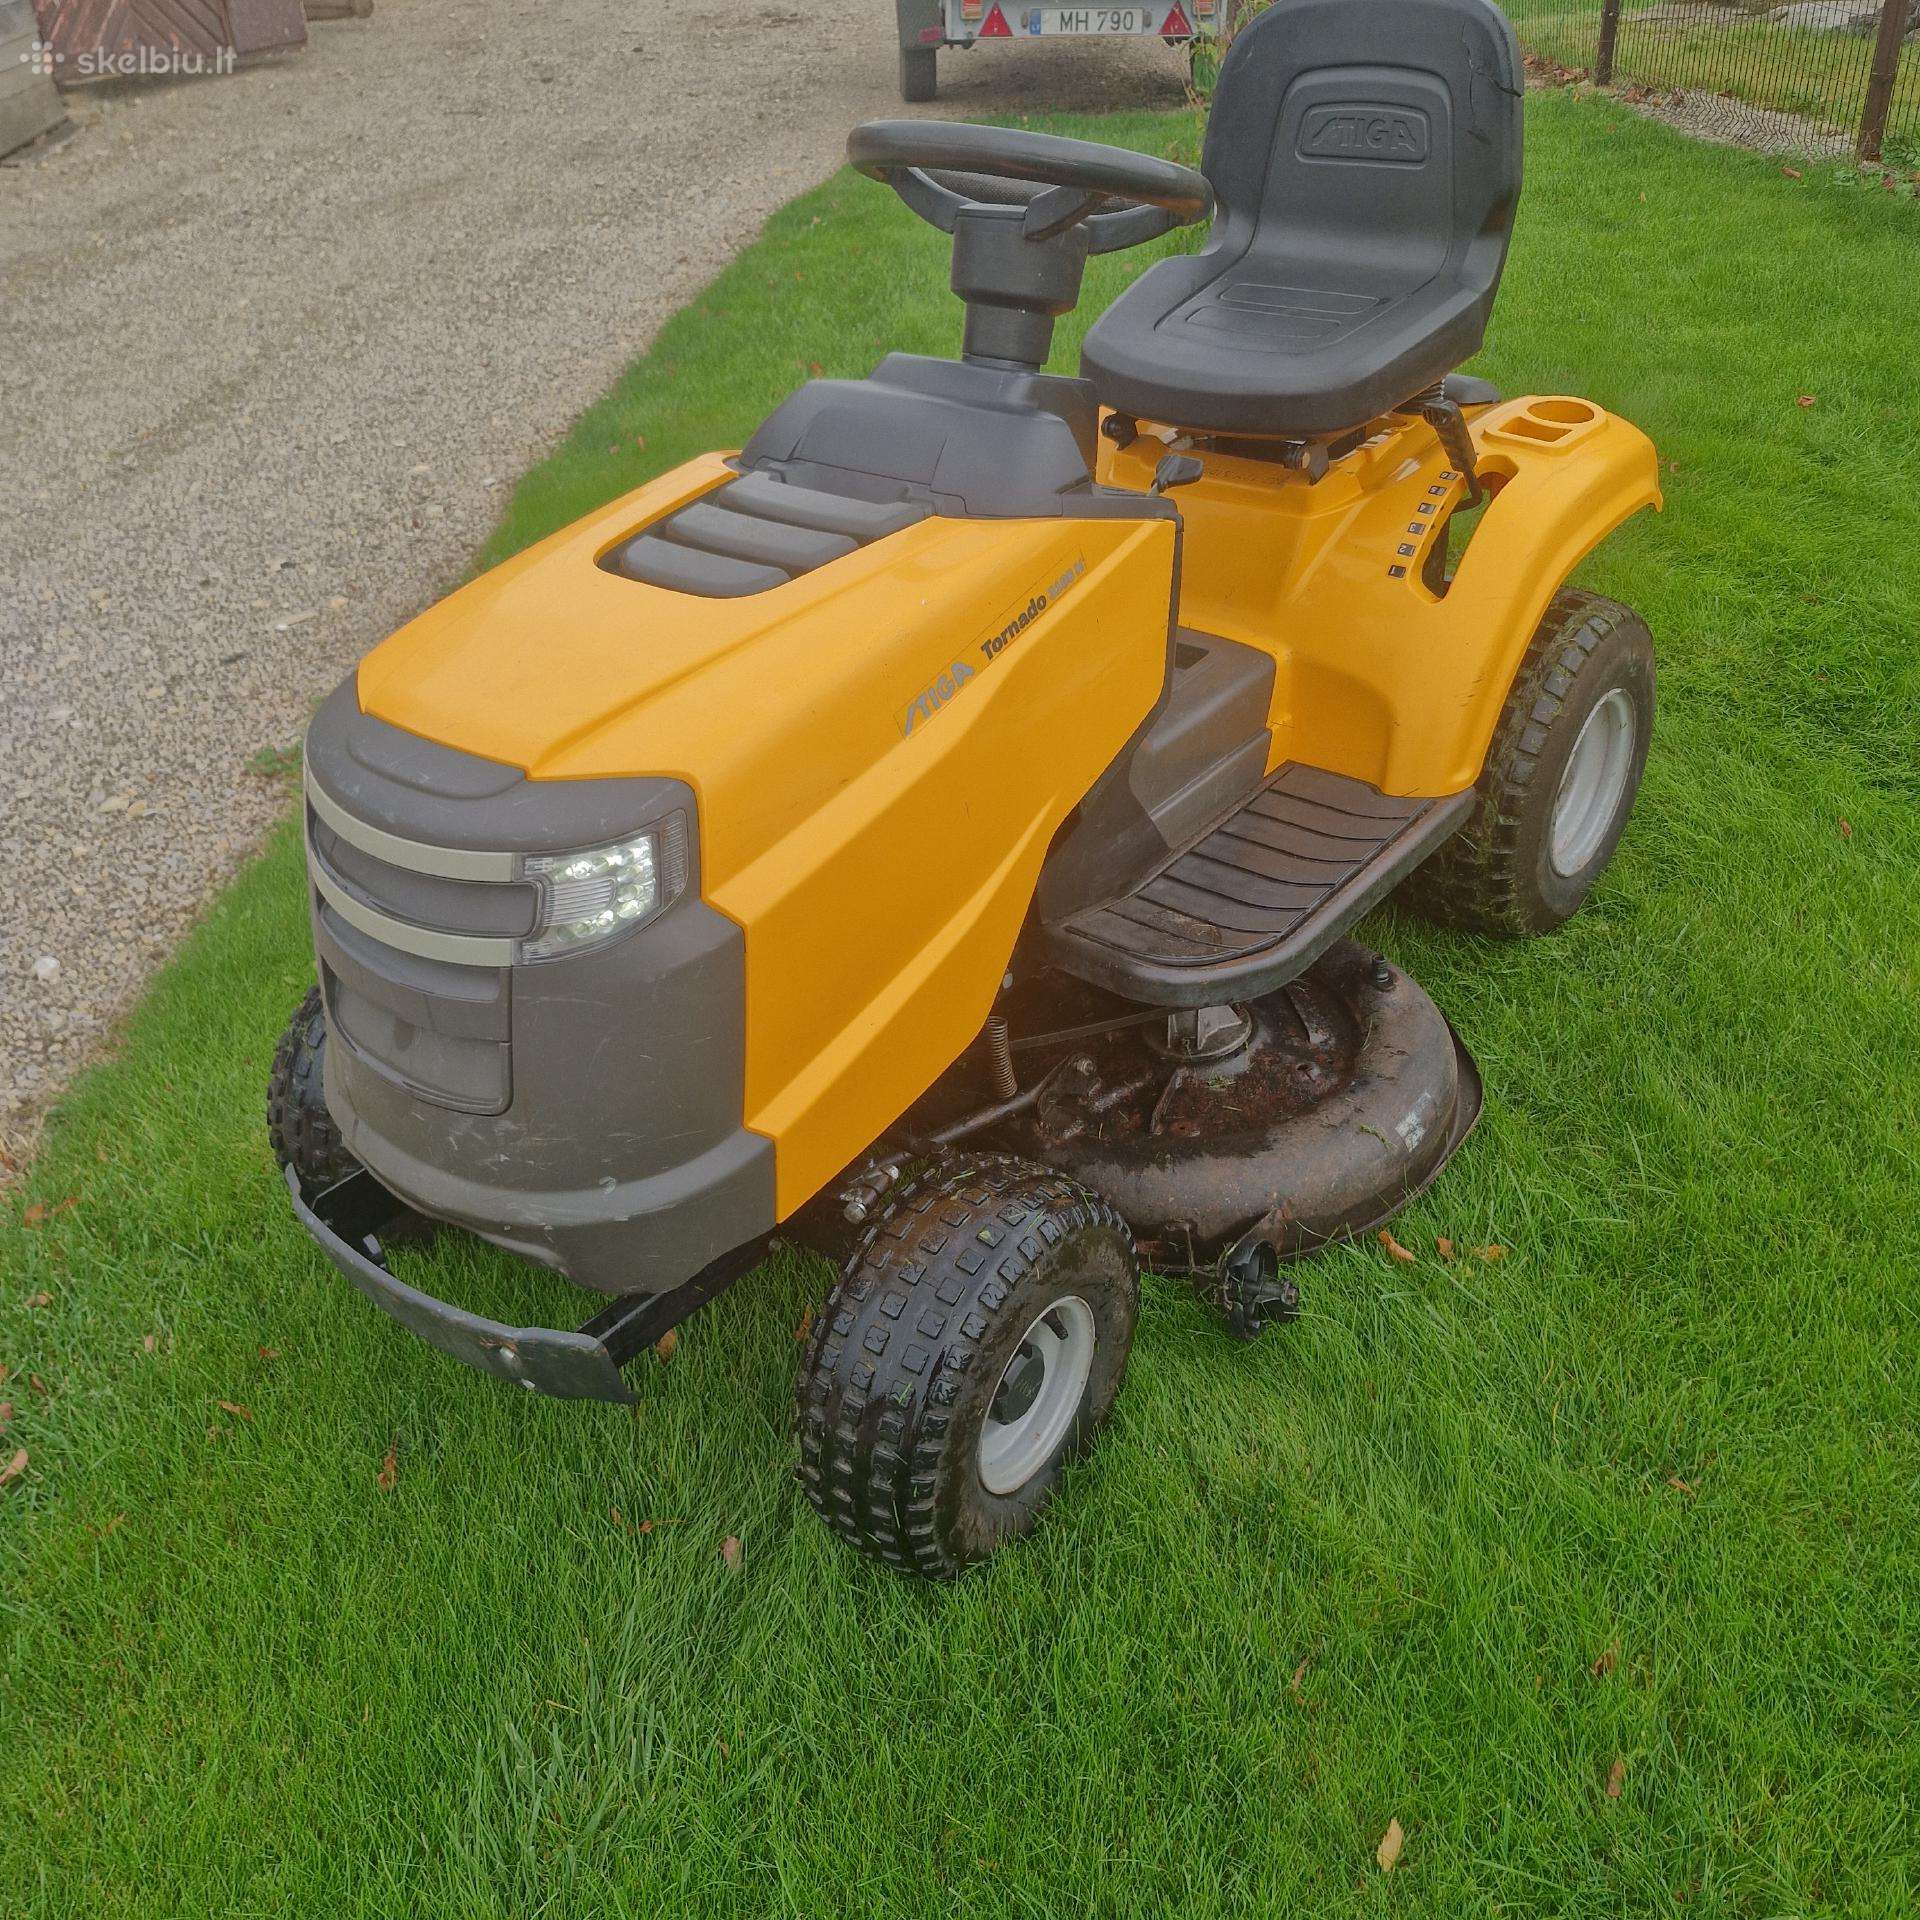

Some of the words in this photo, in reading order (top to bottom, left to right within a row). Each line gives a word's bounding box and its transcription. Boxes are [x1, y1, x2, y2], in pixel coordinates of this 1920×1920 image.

[1060, 10, 1088, 32] MH
[1096, 10, 1134, 31] 790
[1311, 116, 1418, 151] STIGA
[905, 661, 975, 736] STIGA
[980, 595, 1048, 660] Tornado
